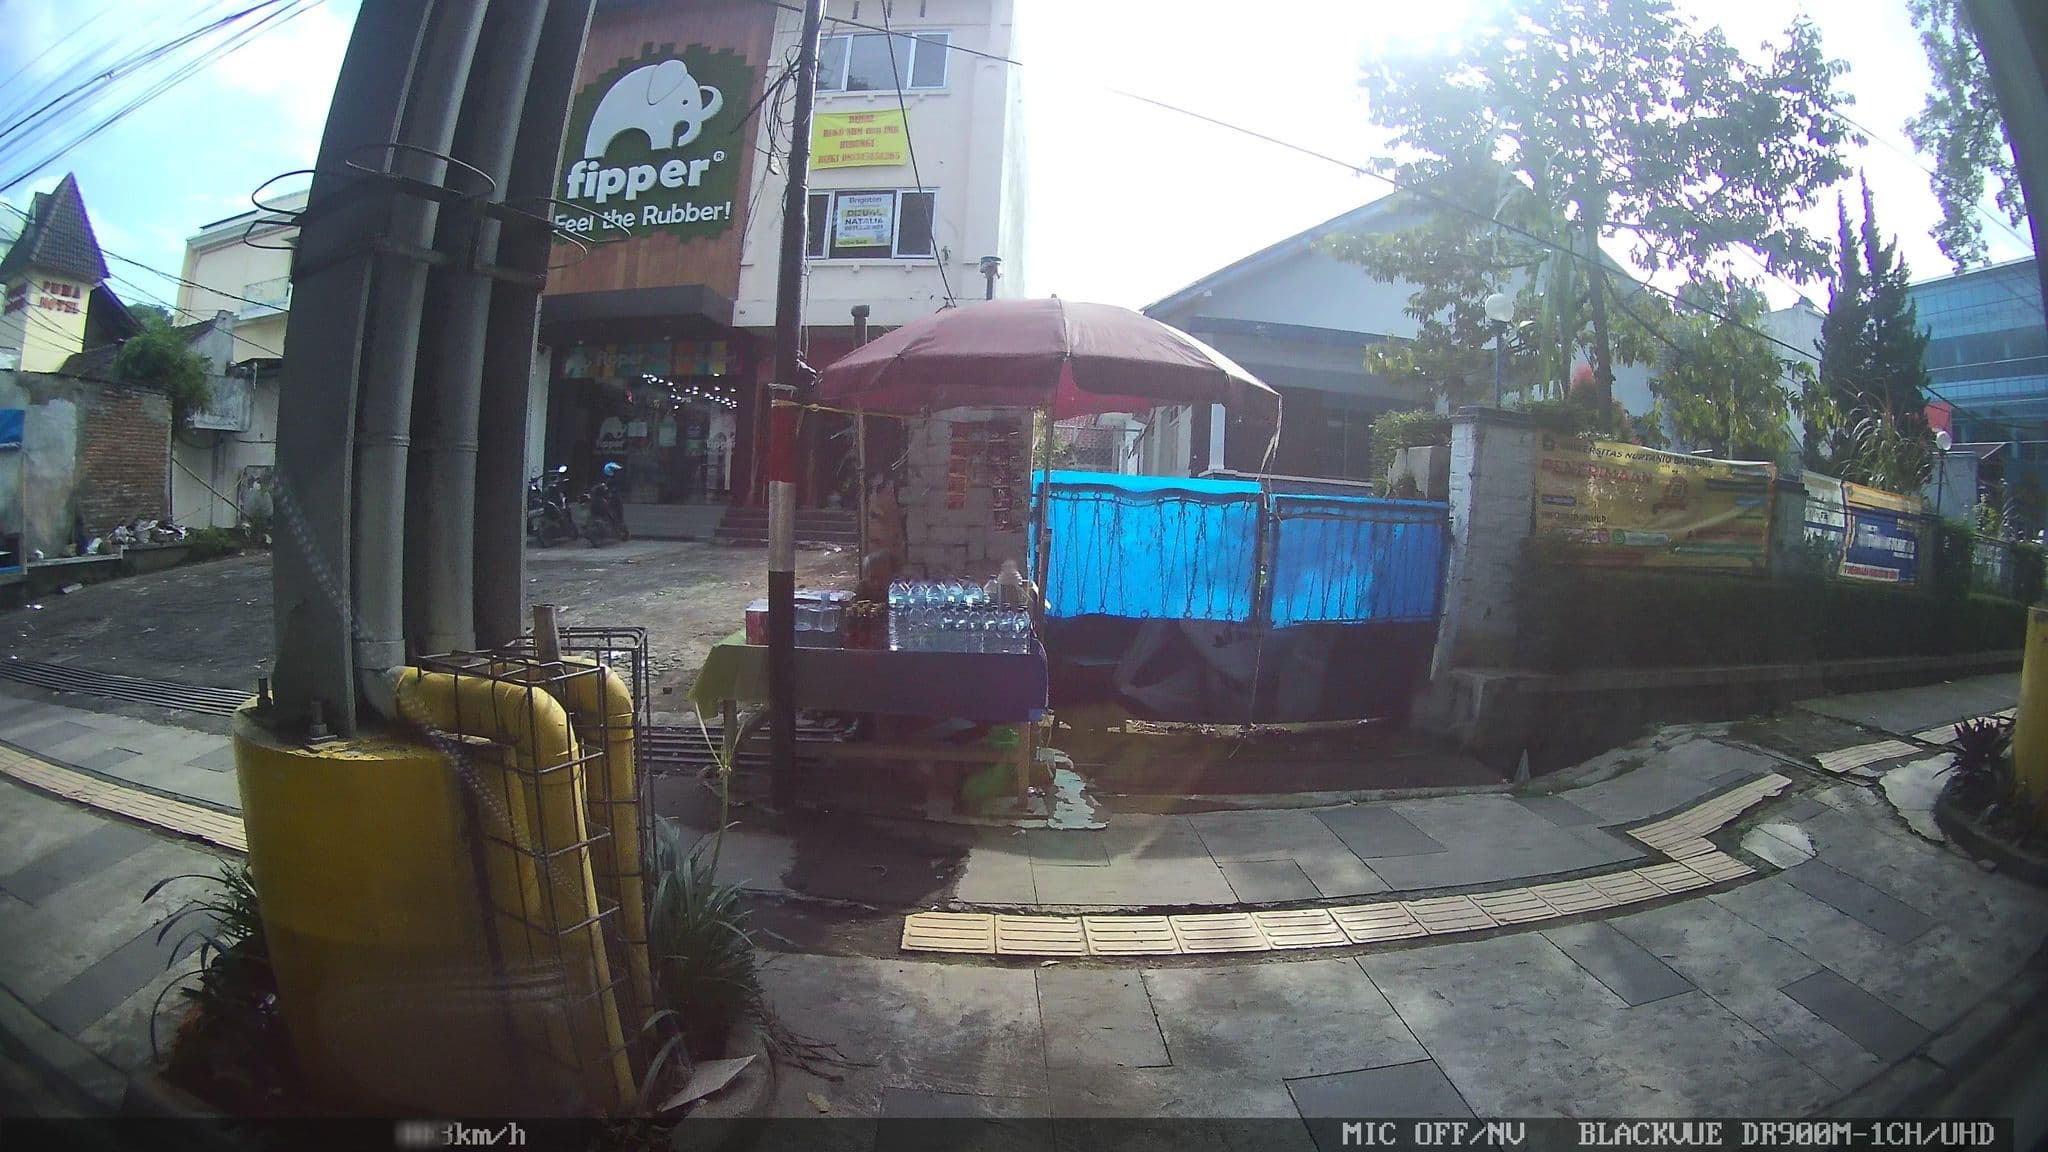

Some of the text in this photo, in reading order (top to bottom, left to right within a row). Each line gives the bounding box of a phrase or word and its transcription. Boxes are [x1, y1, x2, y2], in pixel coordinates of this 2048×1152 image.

[566, 159, 711, 204] fipper
[554, 201, 732, 232] Feel the Rubber!
